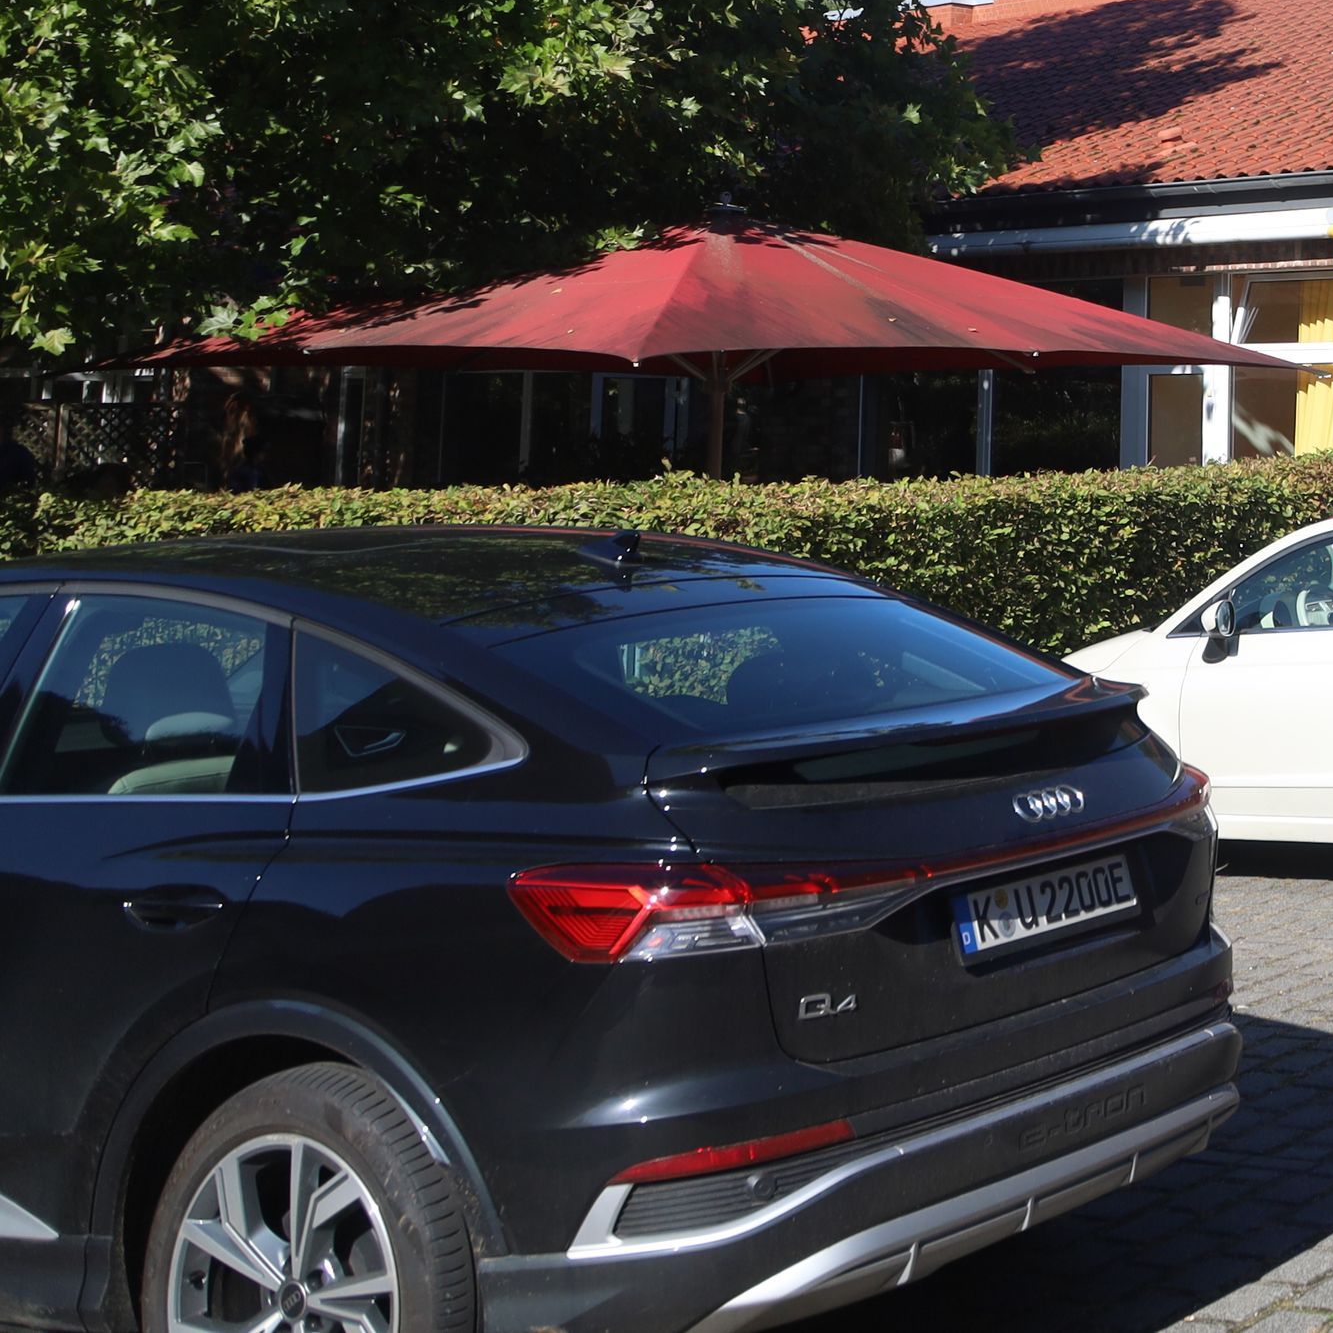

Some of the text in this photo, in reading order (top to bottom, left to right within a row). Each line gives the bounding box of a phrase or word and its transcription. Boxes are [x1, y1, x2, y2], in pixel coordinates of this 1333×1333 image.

[972, 895, 1000, 943] K
[962, 932, 971, 946] D
[798, 993, 857, 1020] Q4
